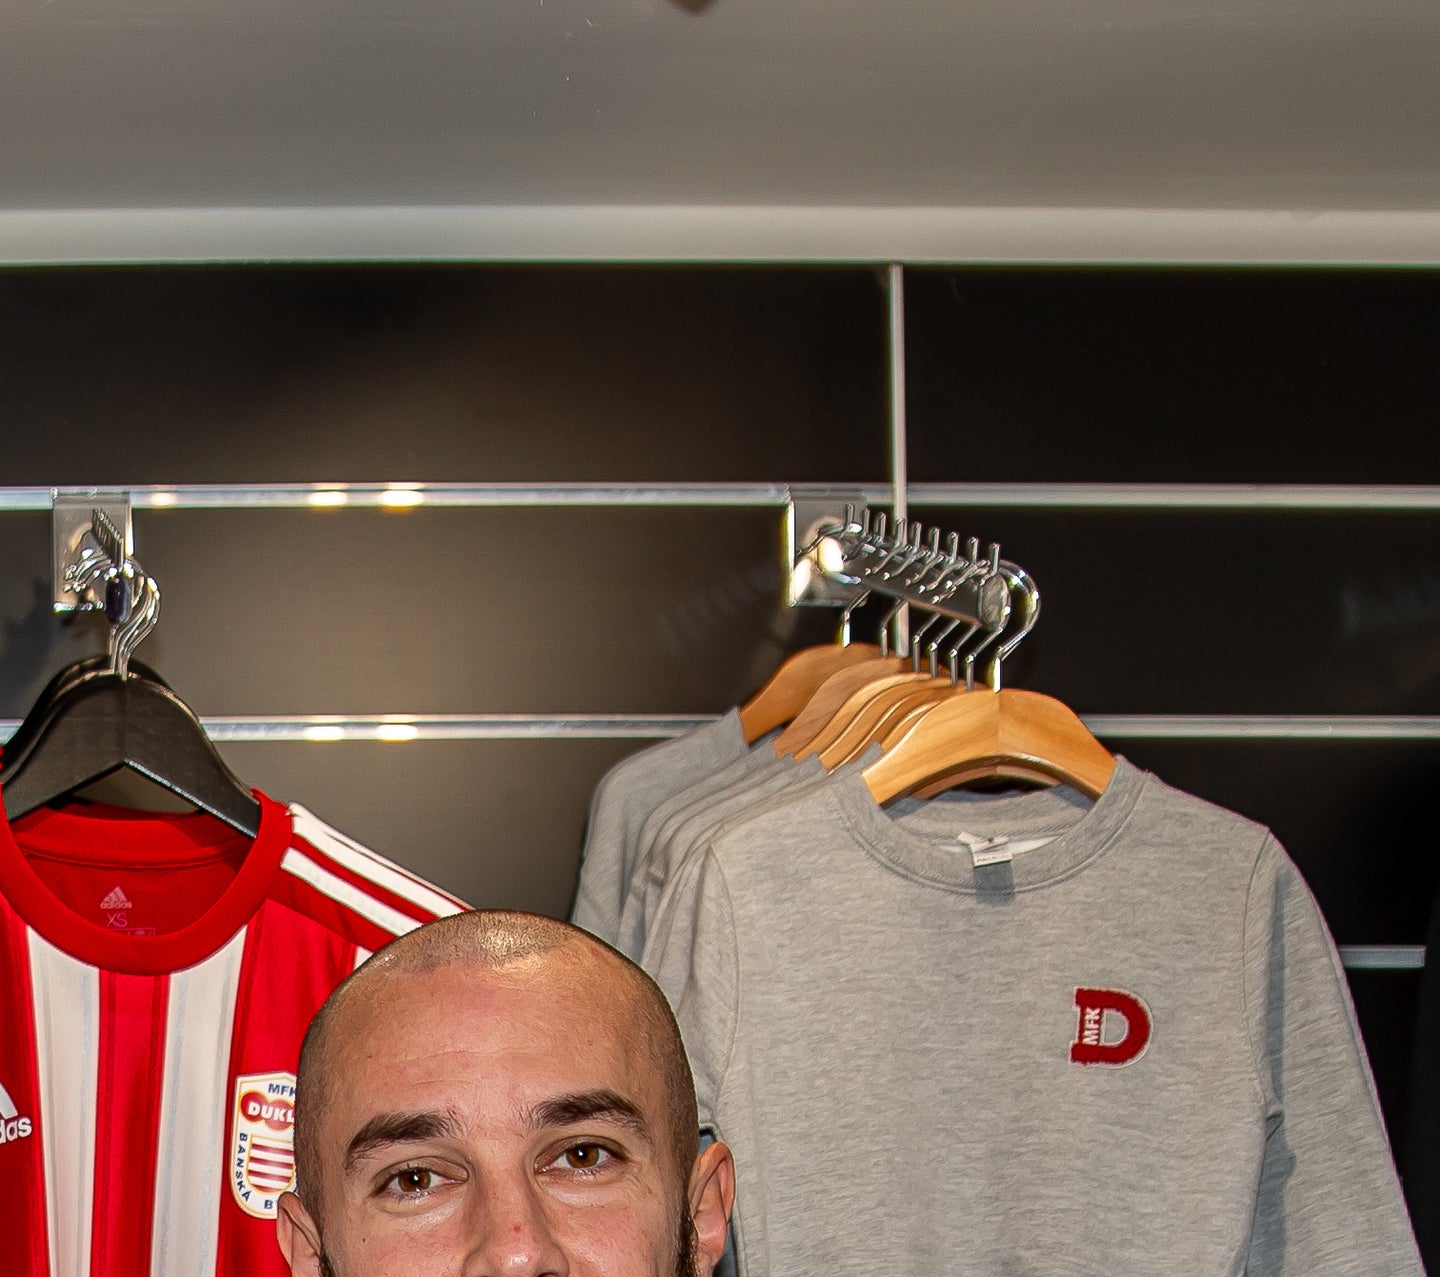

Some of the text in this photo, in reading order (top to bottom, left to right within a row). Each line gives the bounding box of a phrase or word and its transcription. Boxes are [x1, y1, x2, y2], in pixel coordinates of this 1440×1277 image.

[106, 911, 129, 928] XS
[1070, 987, 1152, 1066] D
[247, 1101, 295, 1123] DUKL
